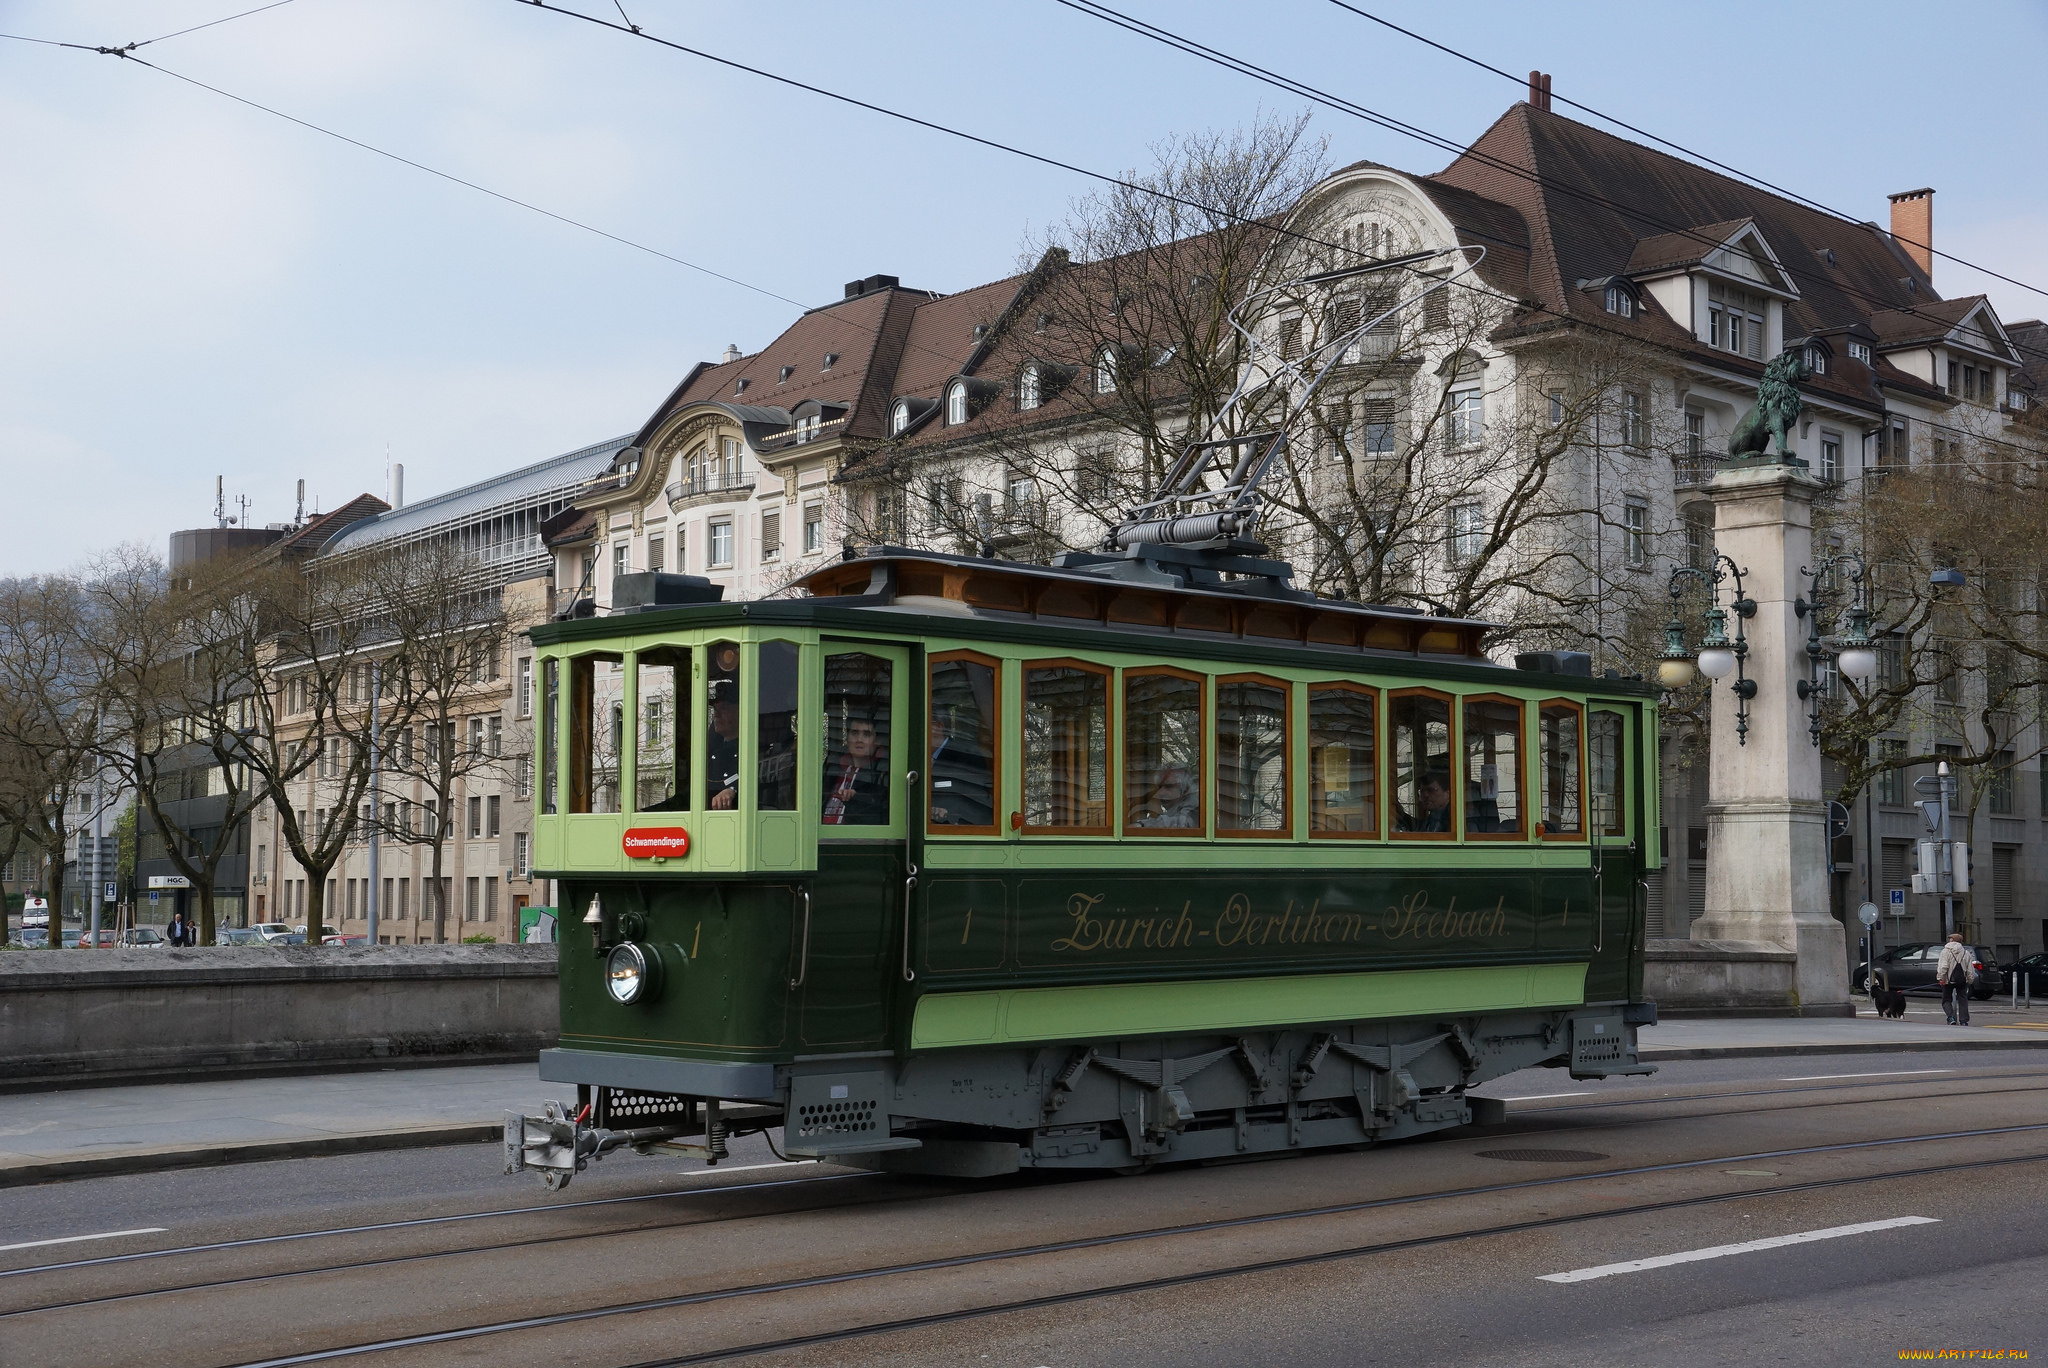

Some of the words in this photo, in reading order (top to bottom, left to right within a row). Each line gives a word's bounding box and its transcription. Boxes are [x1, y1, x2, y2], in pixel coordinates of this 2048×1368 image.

[625, 836, 685, 848] Schwamendingen
[108, 883, 114, 892] P
[961, 907, 973, 945] 1
[1562, 897, 1570, 926] 1
[691, 921, 702, 959] 1
